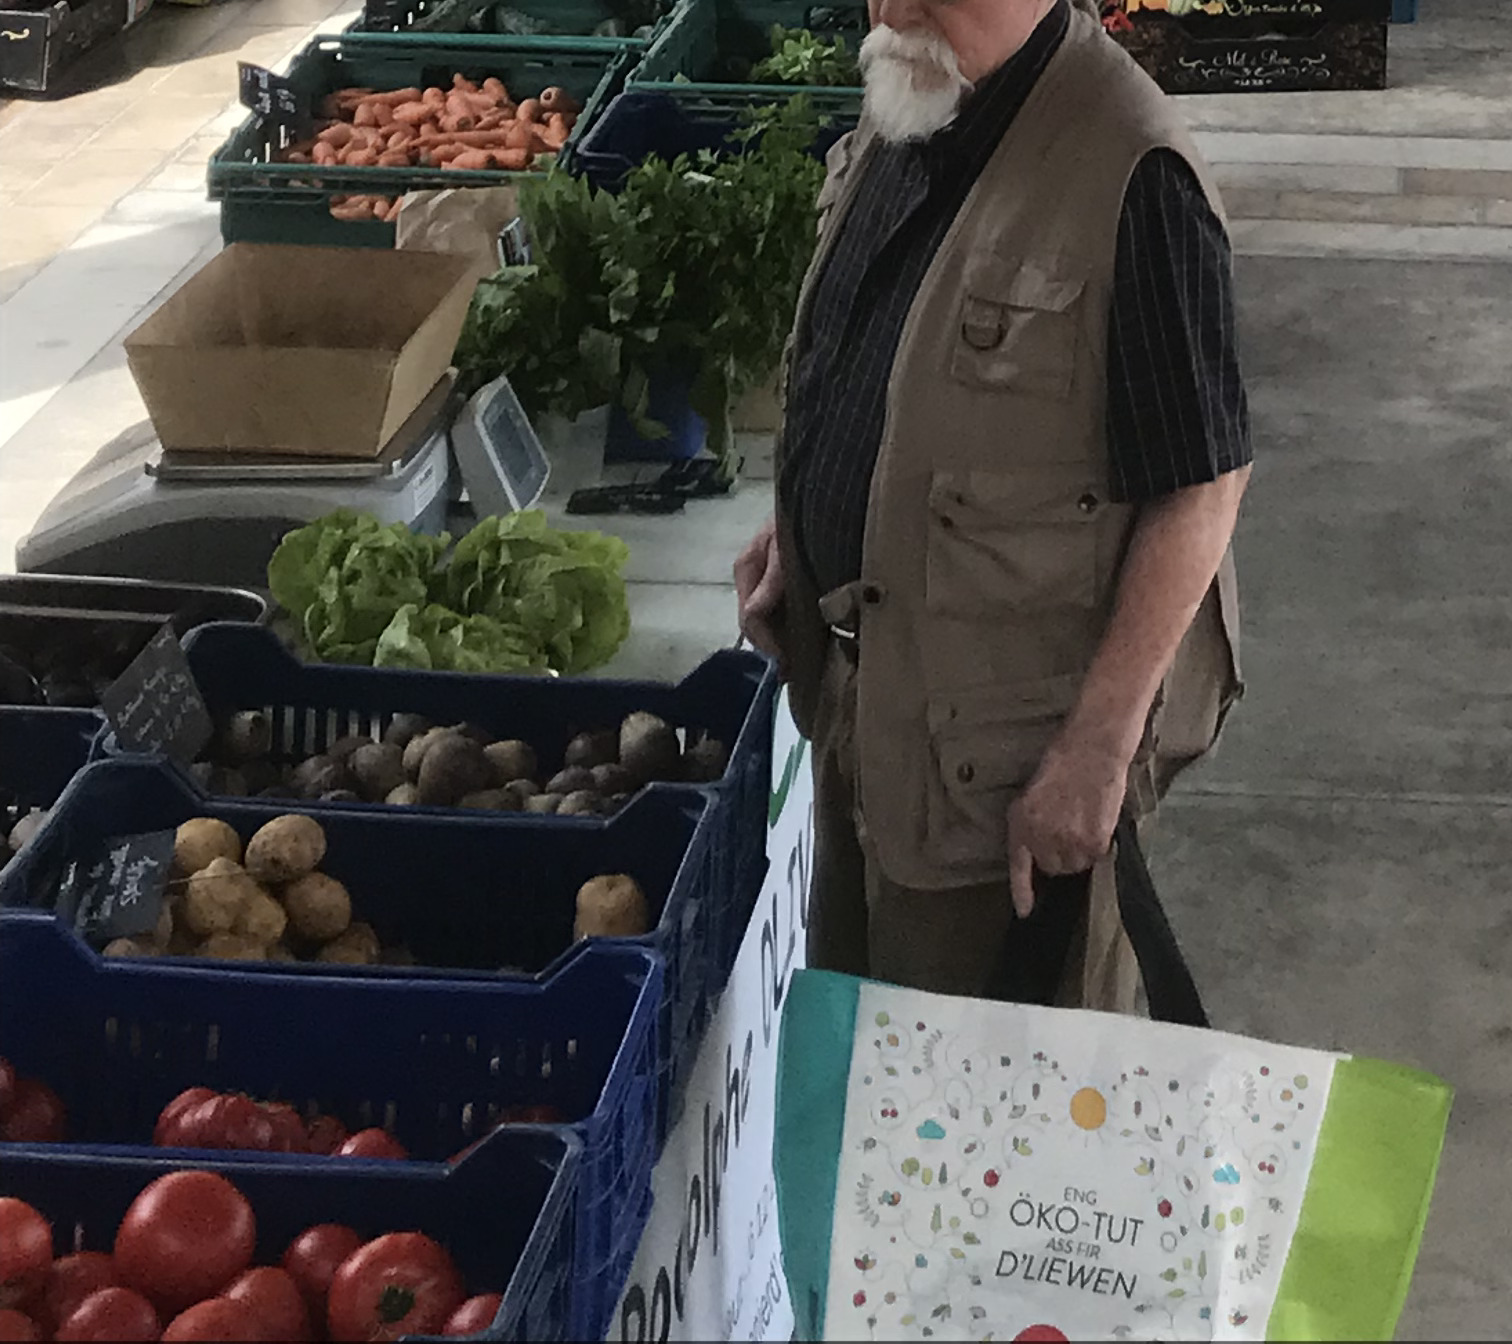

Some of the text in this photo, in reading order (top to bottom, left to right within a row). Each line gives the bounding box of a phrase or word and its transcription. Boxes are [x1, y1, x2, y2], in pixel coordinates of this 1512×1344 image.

[1063, 1187, 1098, 1205] ENG
[1009, 1192, 1145, 1246] ÖKO-TUT
[1045, 1237, 1101, 1259] ASS FIR
[995, 1250, 1138, 1299] D'LIEWEN
